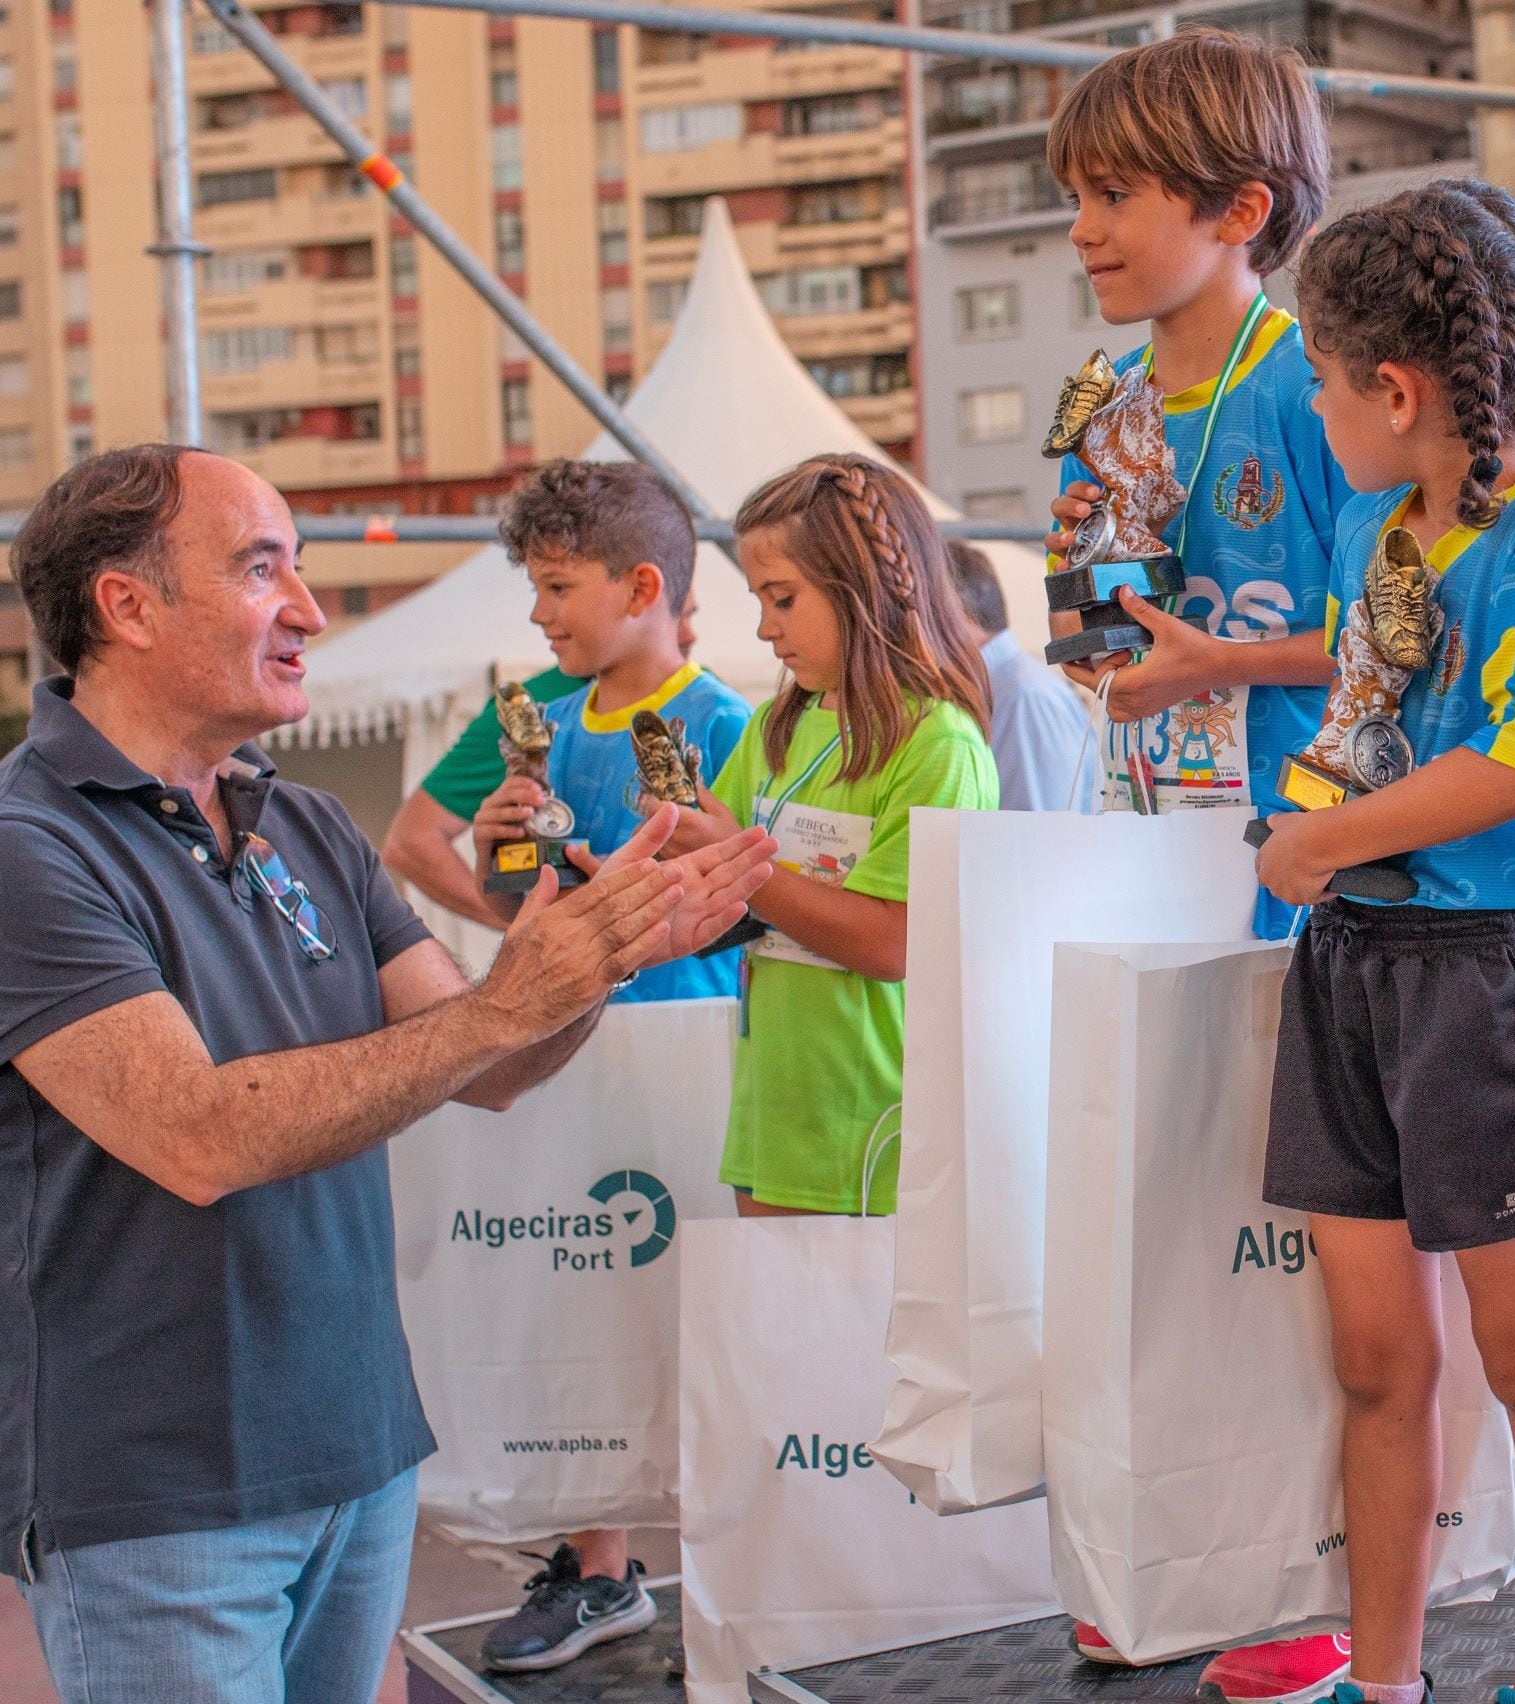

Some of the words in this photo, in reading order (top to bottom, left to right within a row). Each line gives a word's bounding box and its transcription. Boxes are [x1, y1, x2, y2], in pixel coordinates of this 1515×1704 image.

[794, 817, 836, 835] REBECA
[451, 1206, 613, 1248] Algeciras
[553, 1249, 614, 1271] Port
[503, 1435, 628, 1455] www.apba.es
